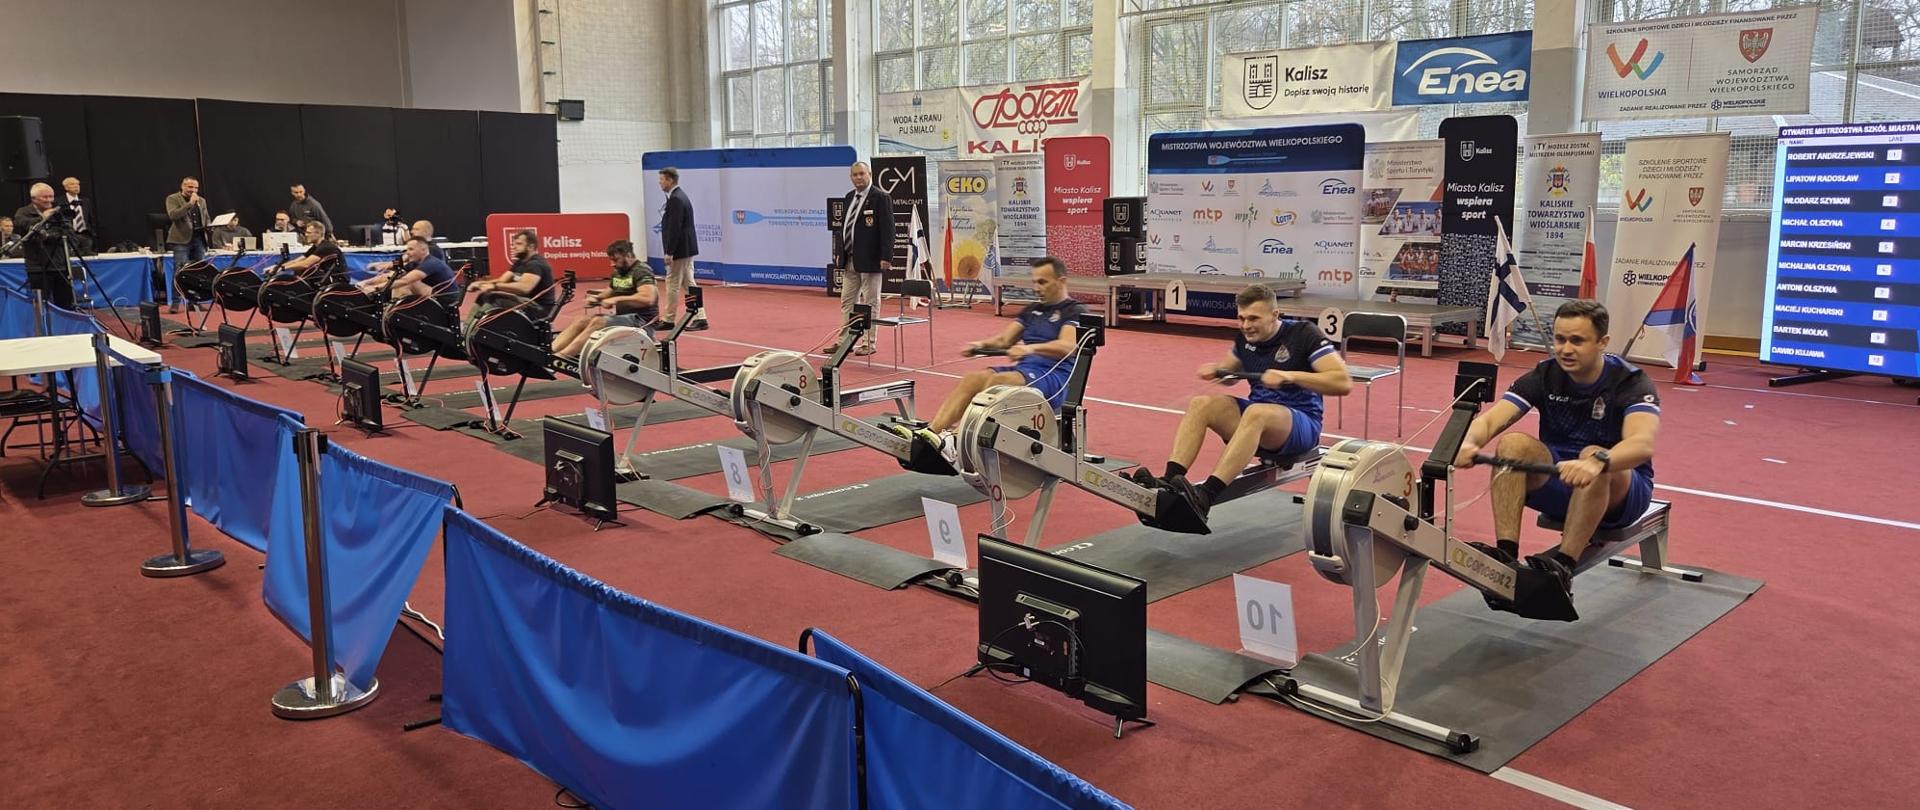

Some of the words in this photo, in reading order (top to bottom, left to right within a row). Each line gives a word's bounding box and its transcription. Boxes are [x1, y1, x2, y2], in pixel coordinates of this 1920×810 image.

[1285, 66, 1328, 82] Kalisz
[1728, 66, 1778, 76] SAMORZĄD
[1417, 67, 1527, 96] Enea
[1716, 74, 1789, 84] WOJEWÓDZTWA
[1284, 86, 1310, 98] Dopisz
[1312, 86, 1337, 97] swoją
[1338, 84, 1369, 95] historię
[1598, 88, 1667, 99] WIELKOPOLSKA
[1709, 84, 1794, 93] WIELKOPOLSKIEGO
[893, 116, 912, 124] WODA
[920, 114, 942, 122] KRANU
[1815, 126, 1862, 135] MISTRZOSTWA
[1864, 125, 1887, 133] SZKÓŁ
[1162, 142, 1207, 150] MISTRZOSTWA
[1209, 139, 1267, 150] WOJEWÓDZTWA
[1269, 136, 1343, 147] WIELKOPOLSKIEGO
[878, 166, 915, 194] GM
[1323, 185, 1355, 194] Enea
[1447, 183, 1476, 192] Miasto
[1478, 183, 1504, 192] Kalisz
[1456, 196, 1493, 206] wspiera
[1193, 208, 1222, 222] mtp
[1276, 214, 1292, 224] LOTTO
[1462, 210, 1486, 220] sport
[1530, 220, 1580, 229] WIOŚLARSKIE
[543, 236, 582, 248] Kalisz
[1263, 245, 1293, 254] Enea
[1779, 262, 1816, 270] MICHALINA
[1817, 264, 1851, 272] OLSZYNA
[1318, 269, 1353, 284] mtp
[1804, 285, 1837, 293] OLSZYNA
[1172, 286, 1179, 305] 1
[1802, 306, 1843, 316] KUCHARSKI
[1325, 315, 1337, 335] 3
[1773, 326, 1801, 334] BARTEK
[640, 348, 647, 360] 7
[1772, 347, 1794, 355] DAWID
[1795, 349, 1825, 358] KUJAWA
[800, 375, 807, 389] 8
[1031, 414, 1045, 430] 10
[1404, 472, 1412, 497] 3
